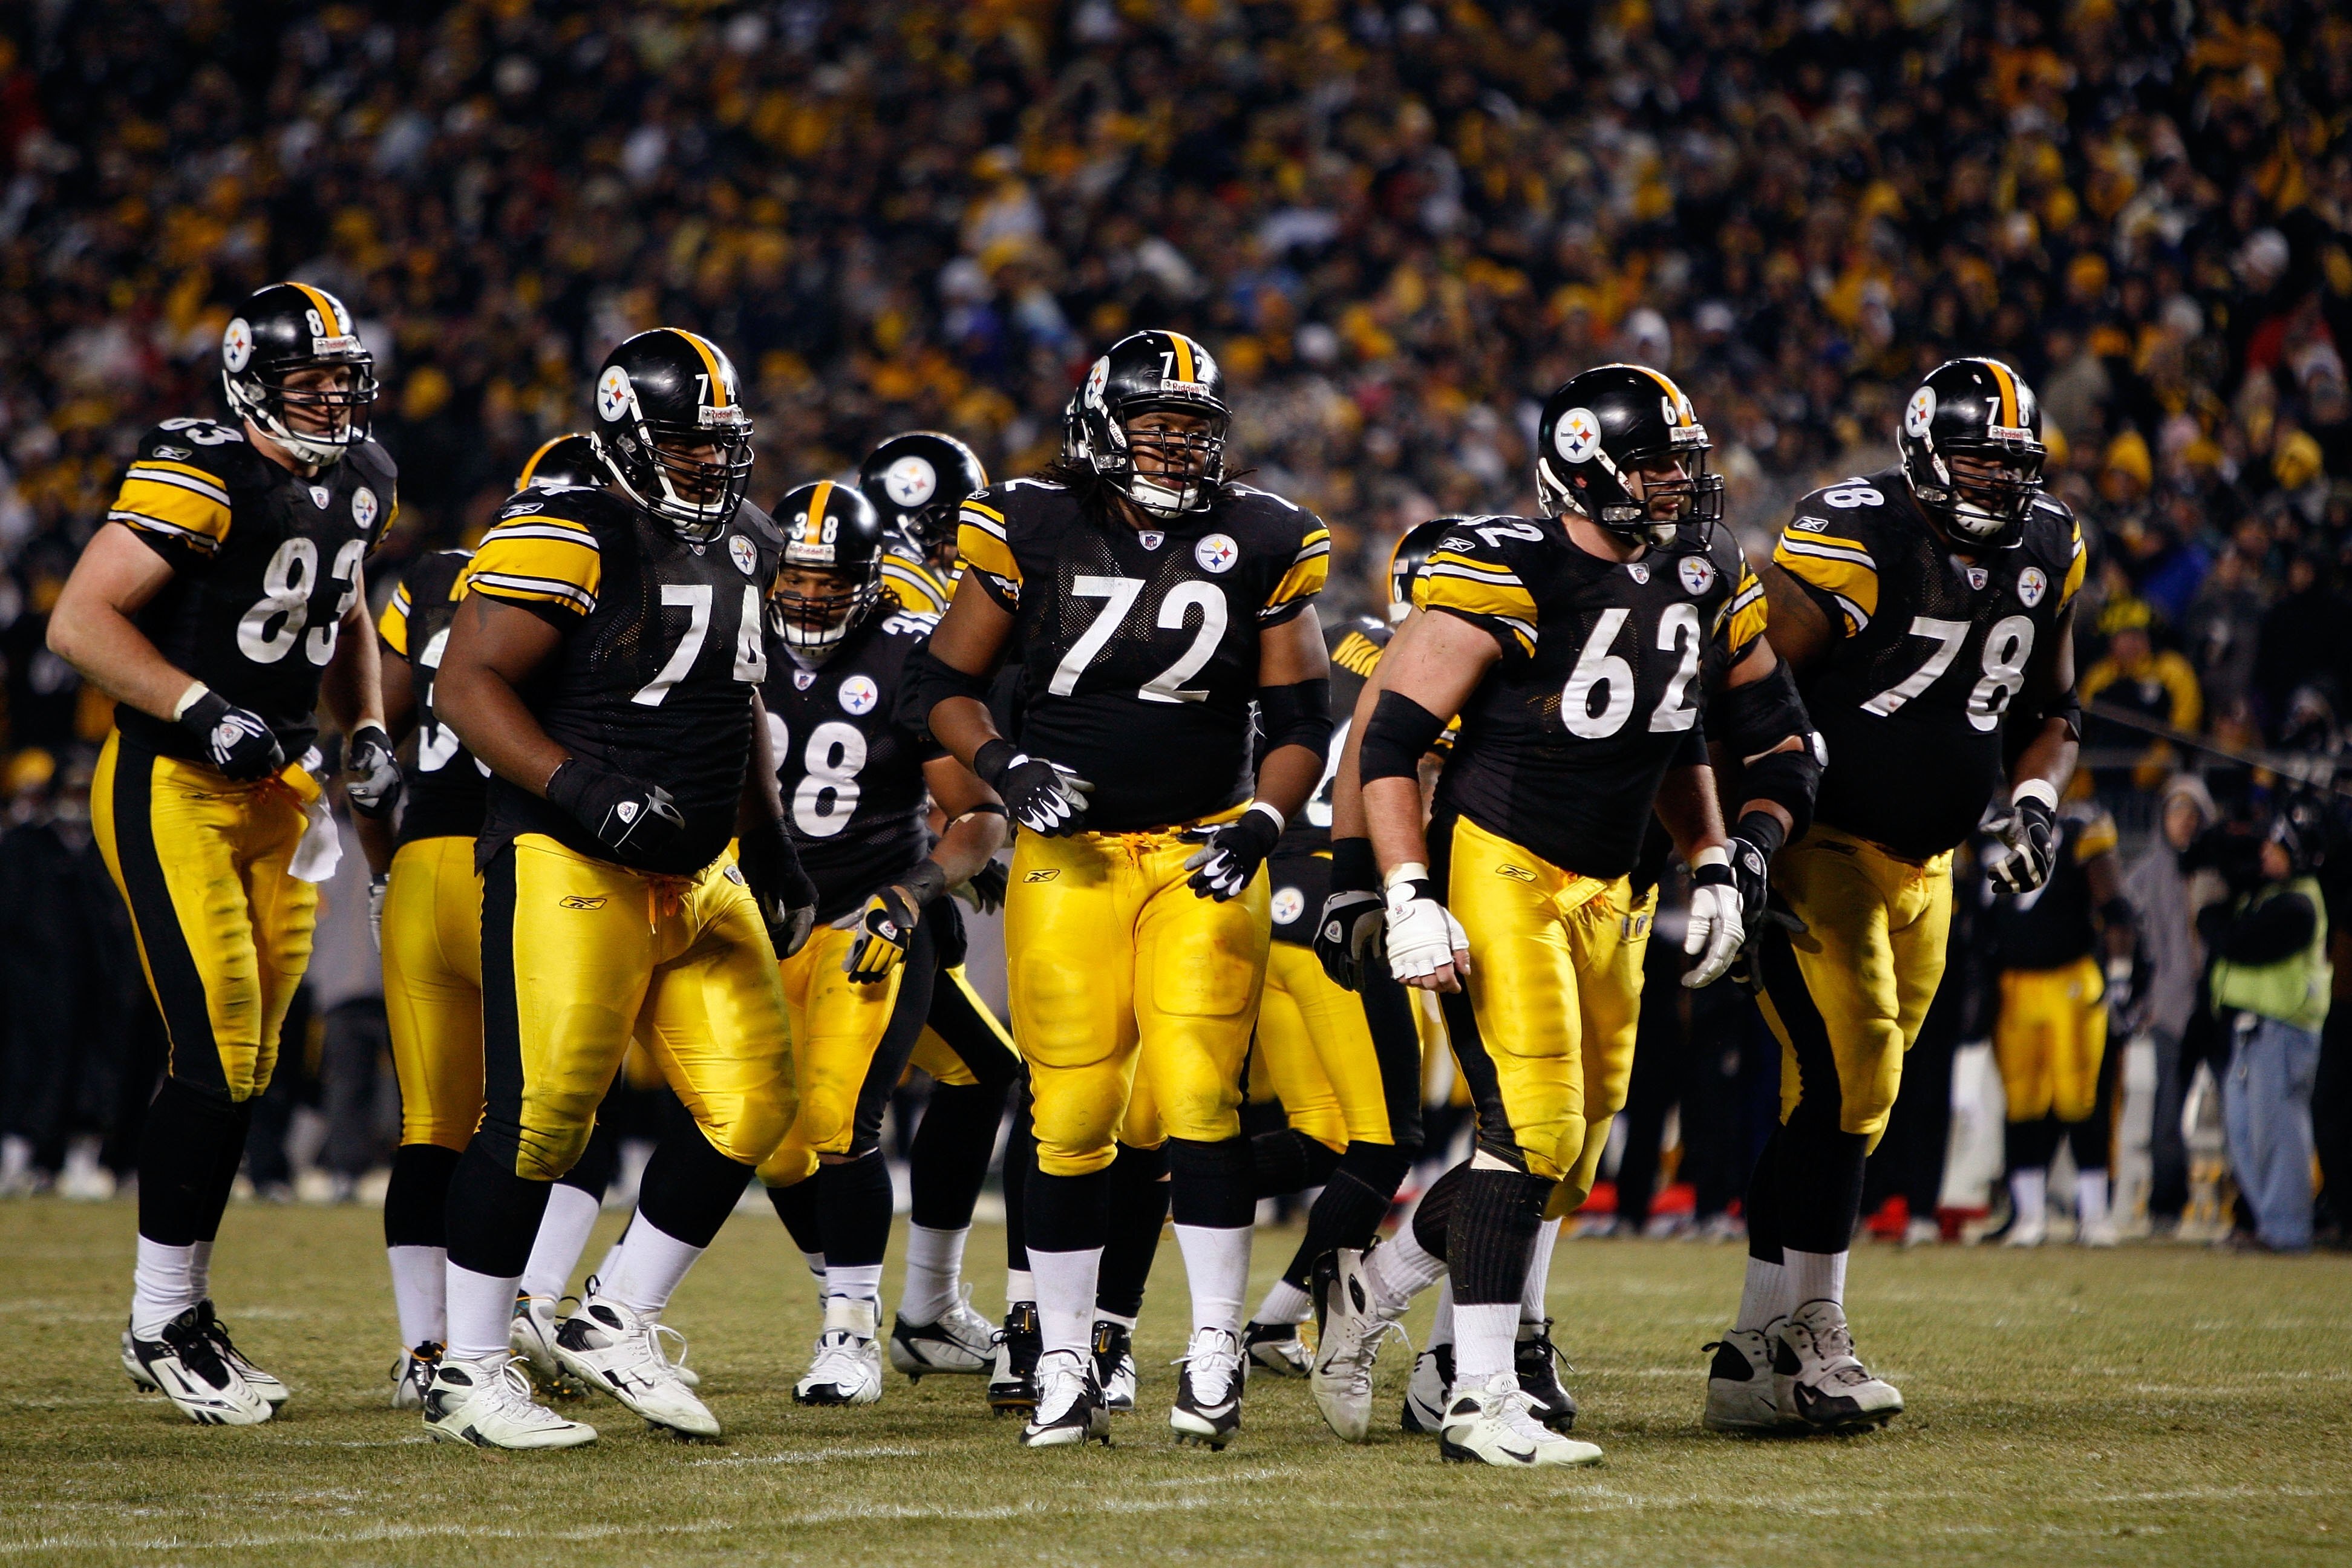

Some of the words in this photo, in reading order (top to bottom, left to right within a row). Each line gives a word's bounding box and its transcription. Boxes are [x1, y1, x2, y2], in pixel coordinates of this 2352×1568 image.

[1160, 351, 1211, 383] 72
[695, 373, 736, 405] 74
[1173, 382, 1200, 394] Riddell
[1661, 394, 1697, 425] 62
[1985, 396, 2030, 427] 78
[791, 512, 839, 544] 38
[237, 537, 368, 666] 83
[881, 610, 942, 644] 3
[1048, 575, 1228, 704] 72
[631, 584, 767, 707] 74
[1561, 603, 1700, 739] 62
[1859, 615, 2035, 732] 78
